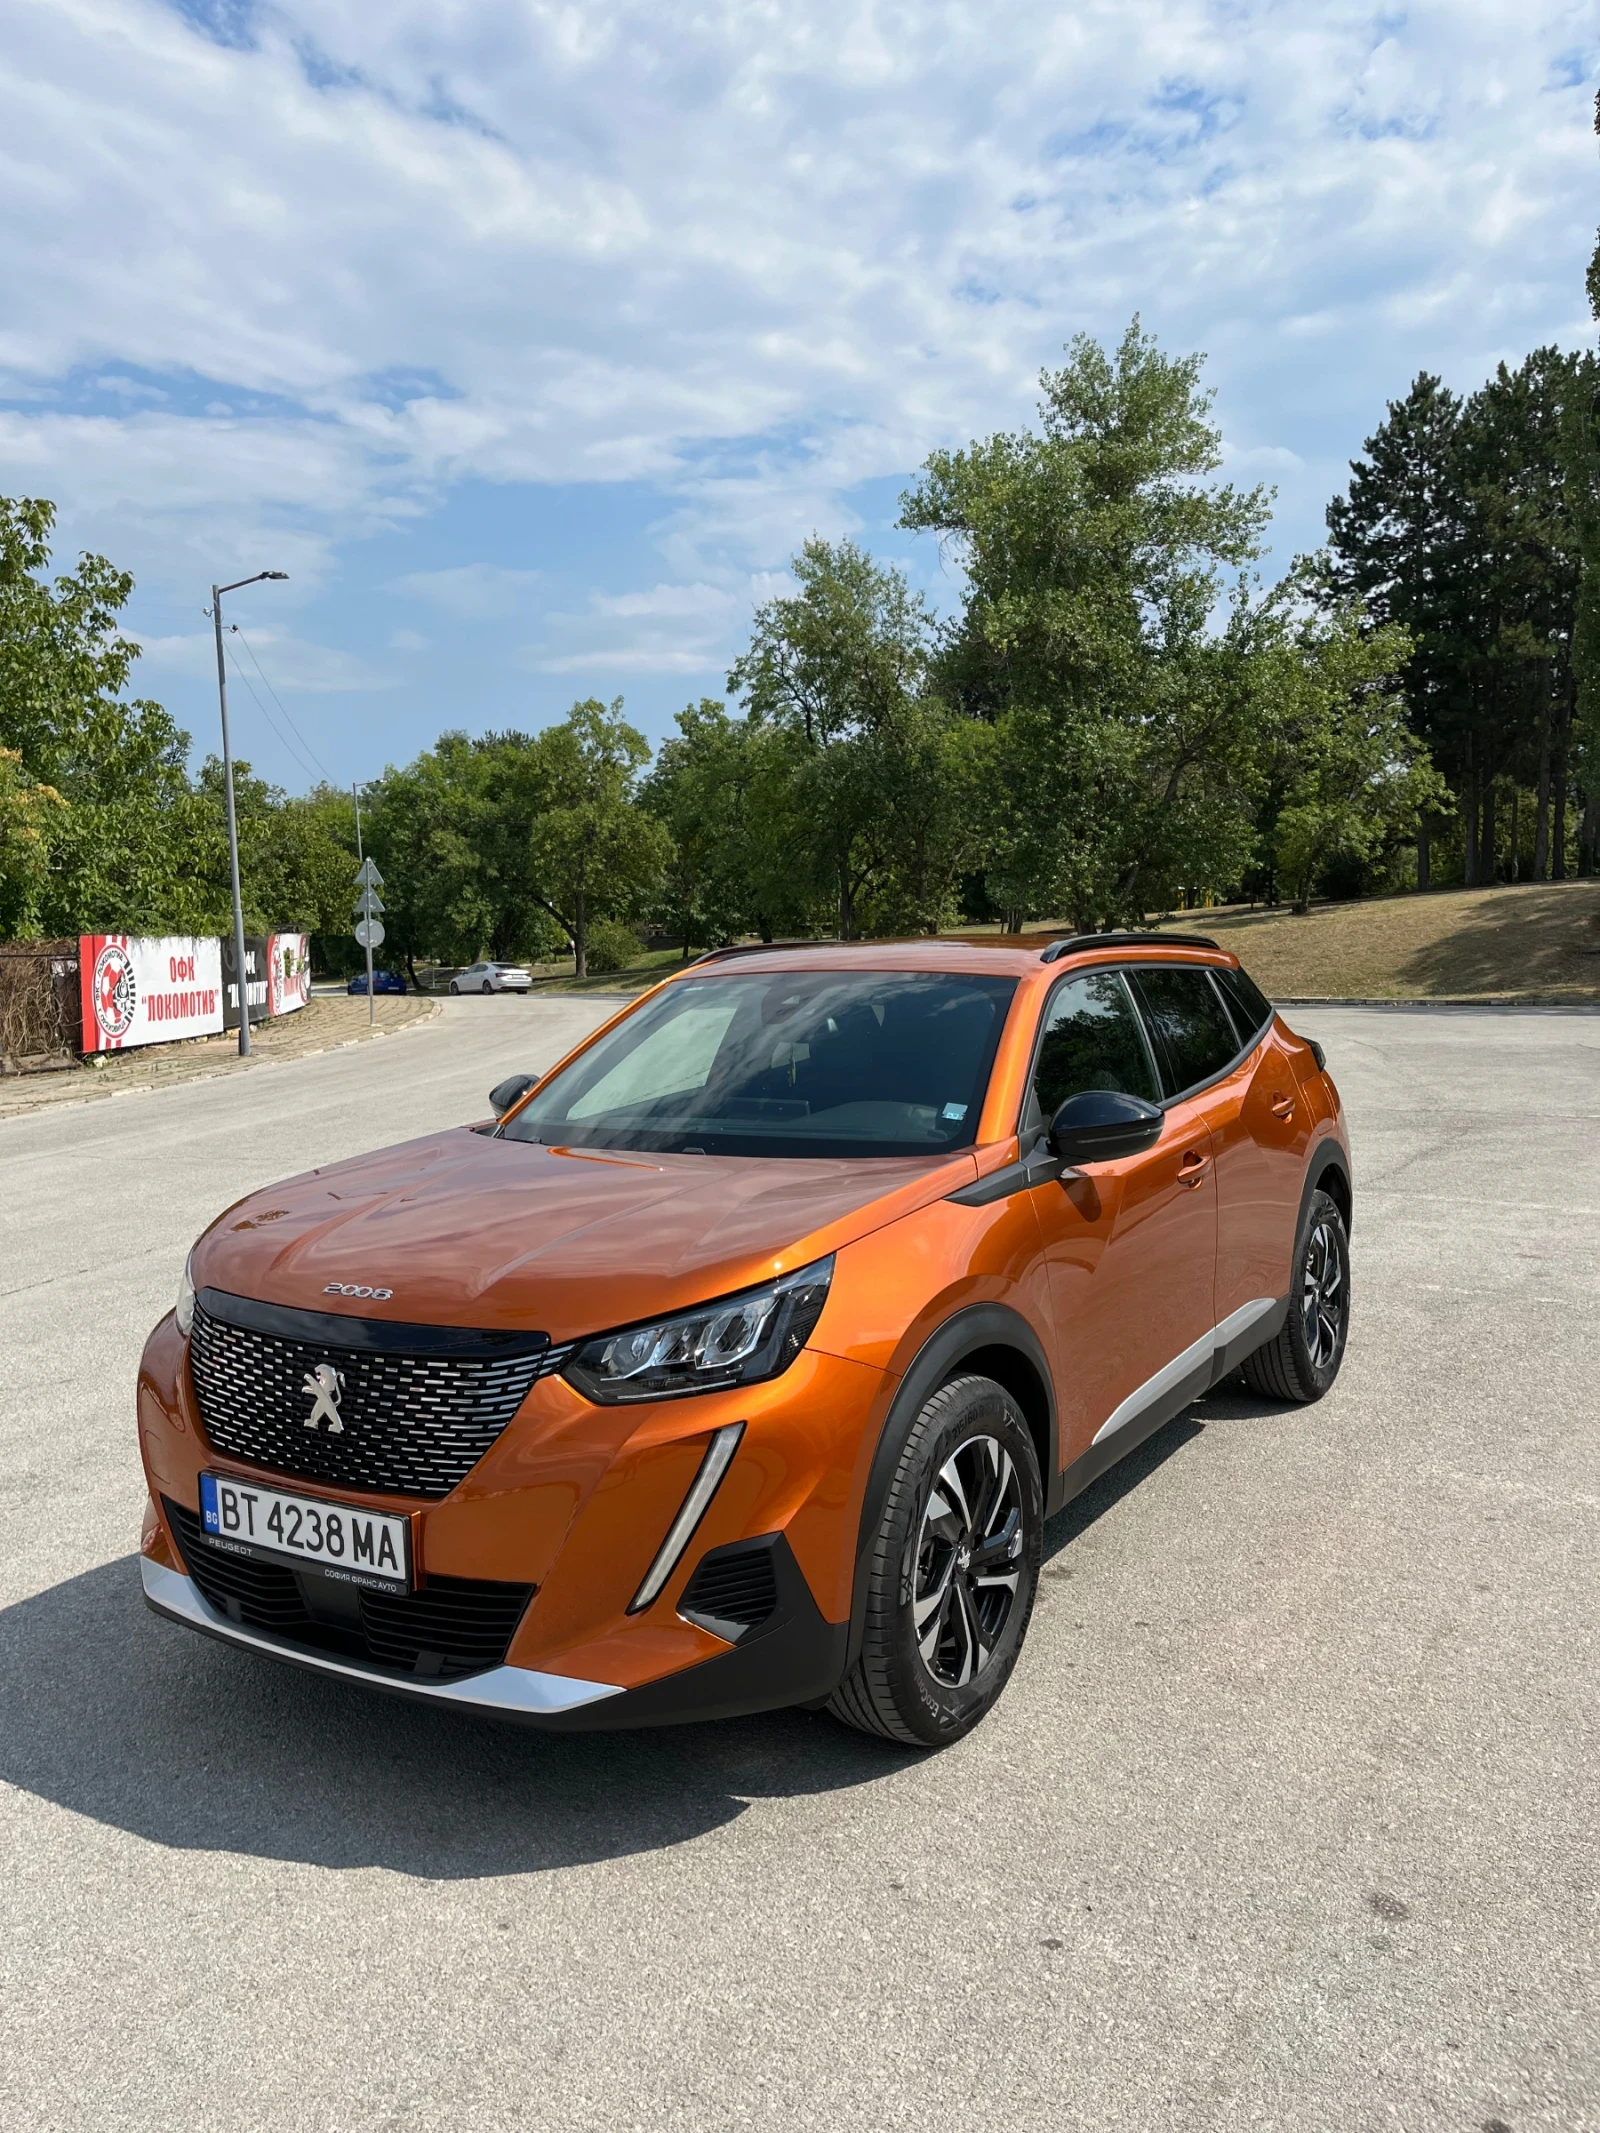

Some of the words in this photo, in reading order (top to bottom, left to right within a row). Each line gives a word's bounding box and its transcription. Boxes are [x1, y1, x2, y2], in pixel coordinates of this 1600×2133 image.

[169, 955, 195, 983] ОФК
[244, 950, 255, 975] ФК
[322, 1282, 393, 1300] 2008
[205, 1510, 218, 1525] BG
[221, 1487, 258, 1537] BT
[267, 1501, 345, 1558] 4238
[352, 1518, 398, 1571] MA
[208, 1538, 252, 1556] PEUGEOT
[324, 1569, 350, 1582] СОФИЯ
[351, 1576, 377, 1588] ФРАНС
[378, 1582, 397, 1592] АУТО
